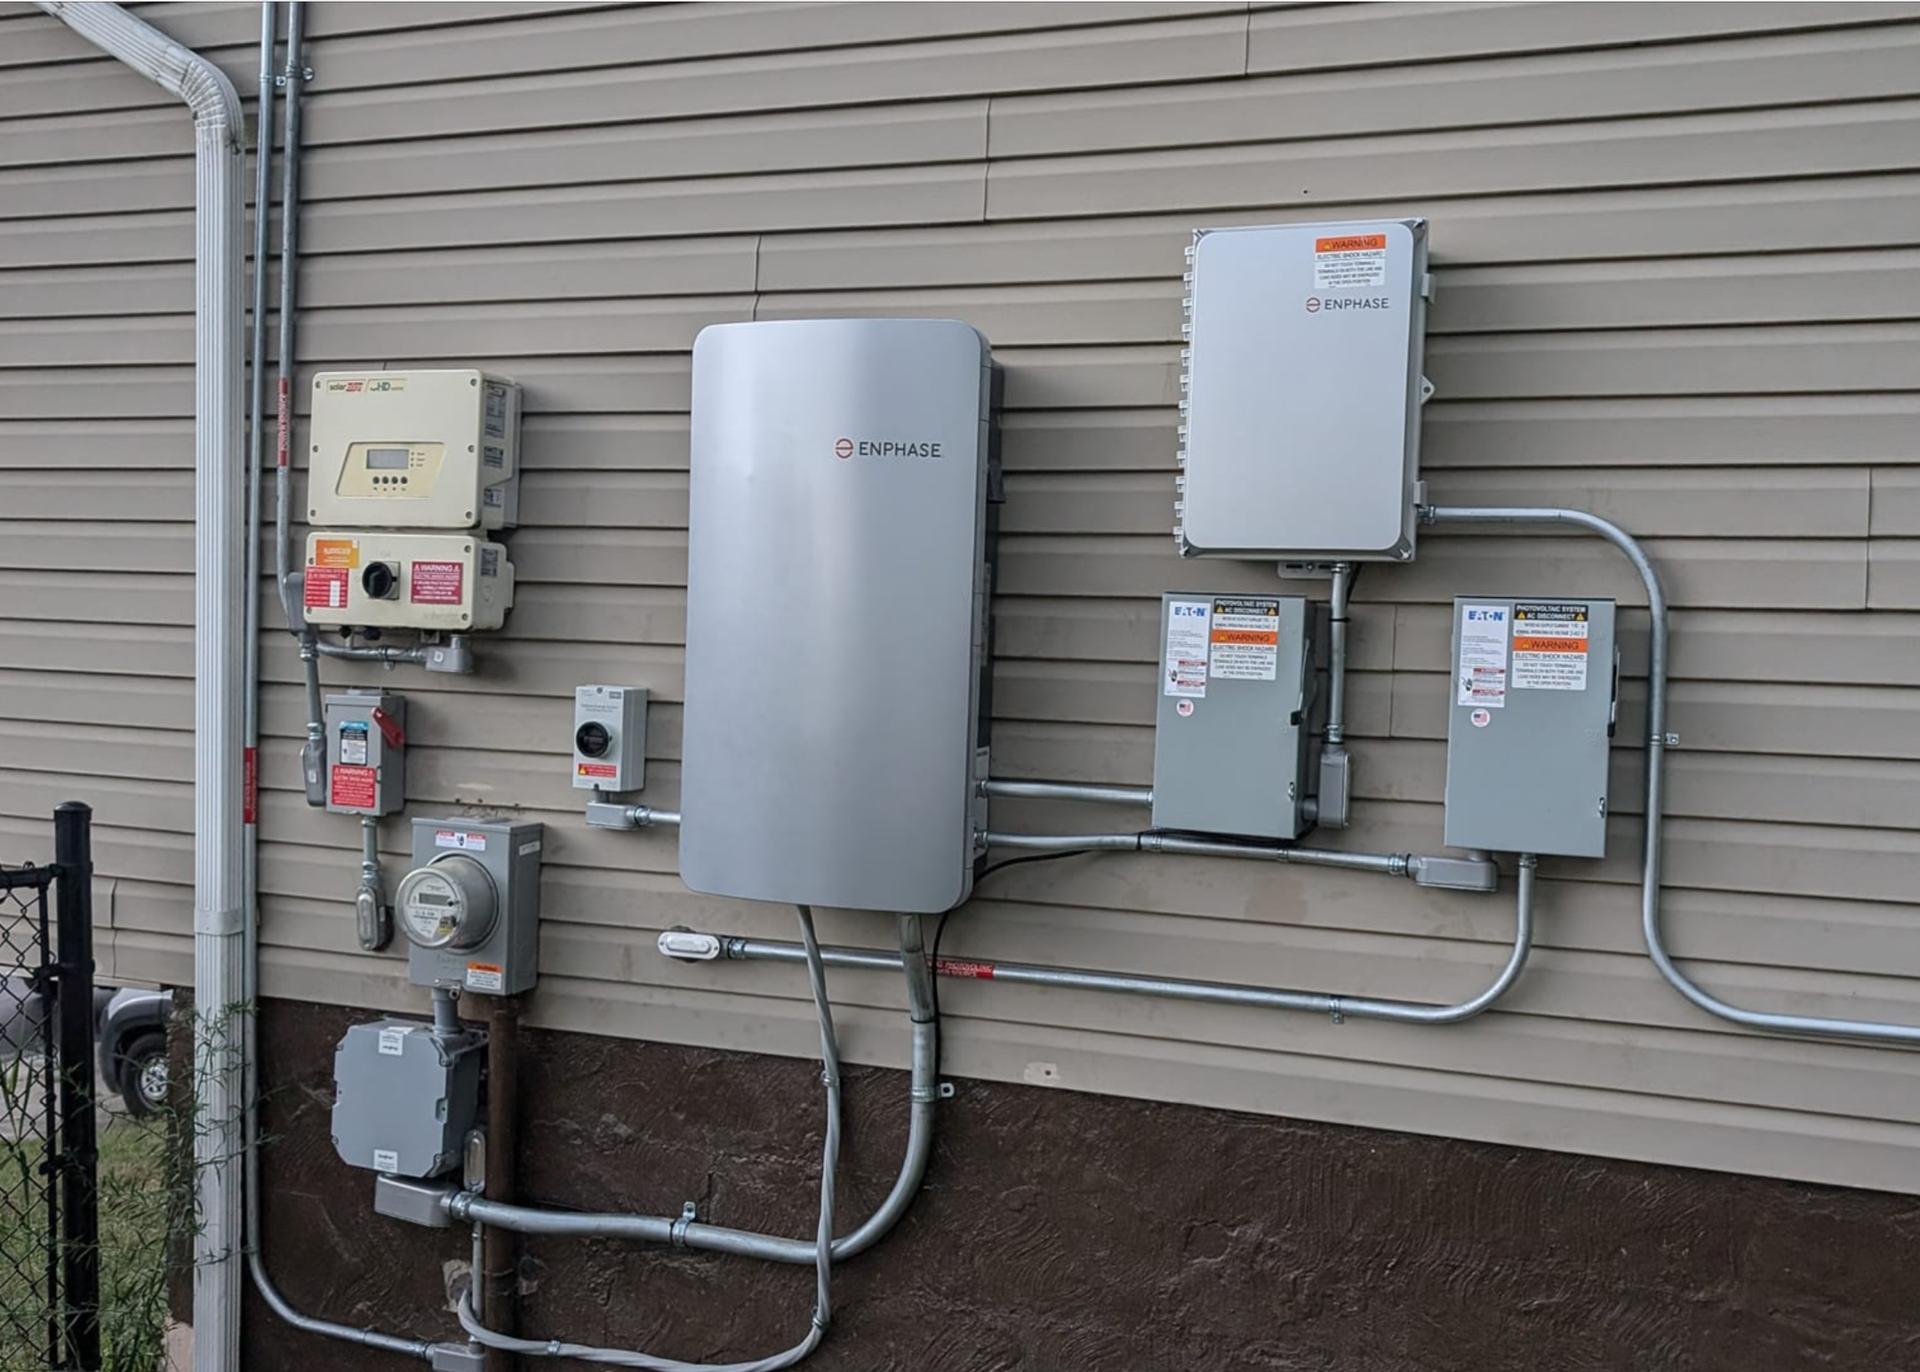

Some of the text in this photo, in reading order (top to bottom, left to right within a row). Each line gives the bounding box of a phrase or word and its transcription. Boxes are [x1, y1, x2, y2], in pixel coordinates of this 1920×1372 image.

[1332, 238, 1378, 249] WARNING
[1325, 298, 1389, 310] ENPHASE
[859, 442, 941, 457] ENPHASE
[421, 564, 453, 572] WARNING
[1235, 607, 1267, 615] DISCONNECT
[1226, 633, 1270, 642] WARNING
[1531, 640, 1579, 650] WARNING
[340, 768, 368, 777] WARNING
